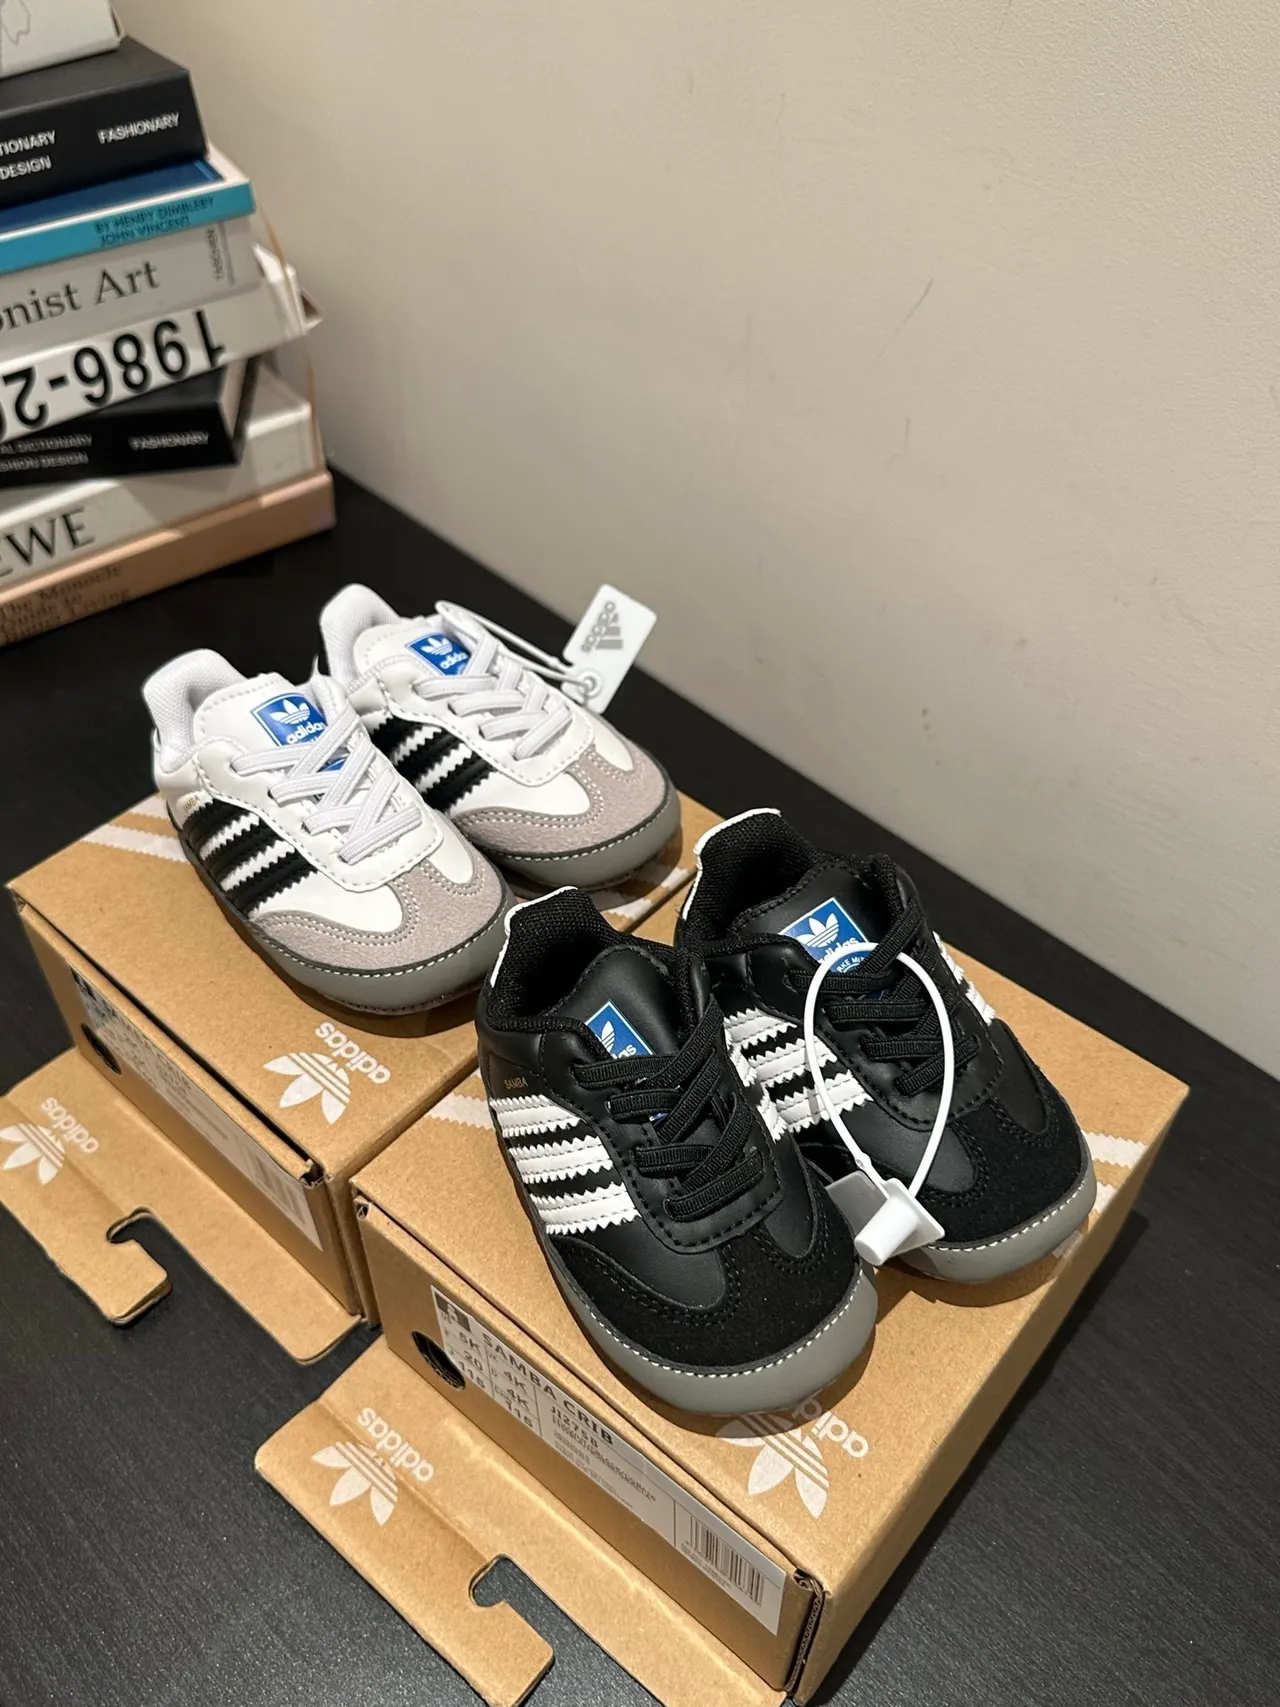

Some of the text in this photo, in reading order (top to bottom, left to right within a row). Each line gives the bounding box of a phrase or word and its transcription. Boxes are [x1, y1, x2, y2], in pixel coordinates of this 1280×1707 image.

[98, 112, 180, 144] FASHIONARY
[0, 155, 52, 180] DESIGN
[0, 261, 160, 331] nist Art
[0, 309, 227, 441] 1986-2
[440, 652, 469, 670] adida
[315, 1022, 391, 1084] adidas
[41, 1097, 99, 1155] adidas
[463, 1349, 484, 1371] 20
[482, 1332, 613, 1445] SAMBA CRIB
[503, 1370, 528, 1393] 4K
[507, 1387, 530, 1410] 4K
[792, 1398, 868, 1457] adid
[358, 1407, 434, 1481] adidas
